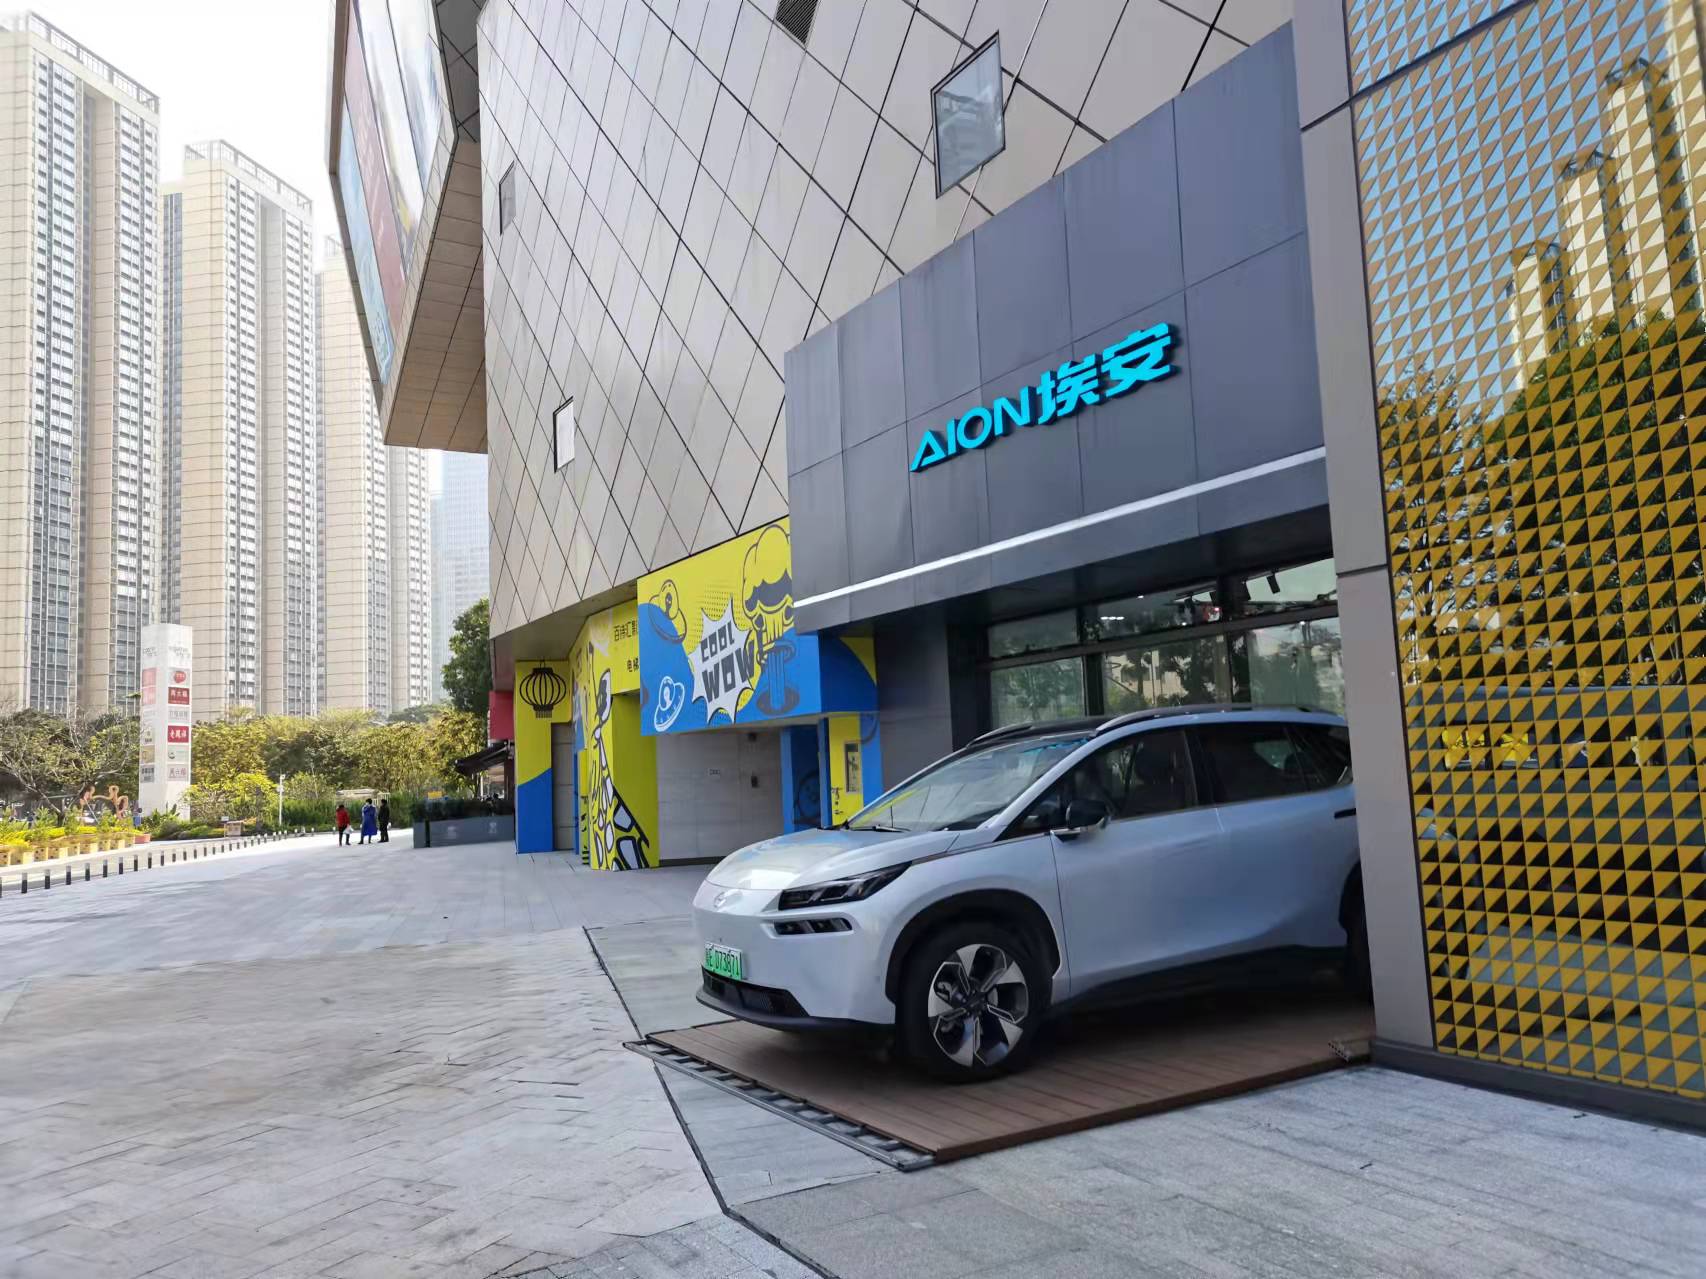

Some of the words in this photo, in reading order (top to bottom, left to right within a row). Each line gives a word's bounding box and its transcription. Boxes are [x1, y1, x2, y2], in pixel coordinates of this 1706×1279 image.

[910, 386, 1030, 473] AION
[1037, 322, 1171, 425] 埃安
[700, 620, 735, 663] COOL
[702, 640, 754, 703] WOW
